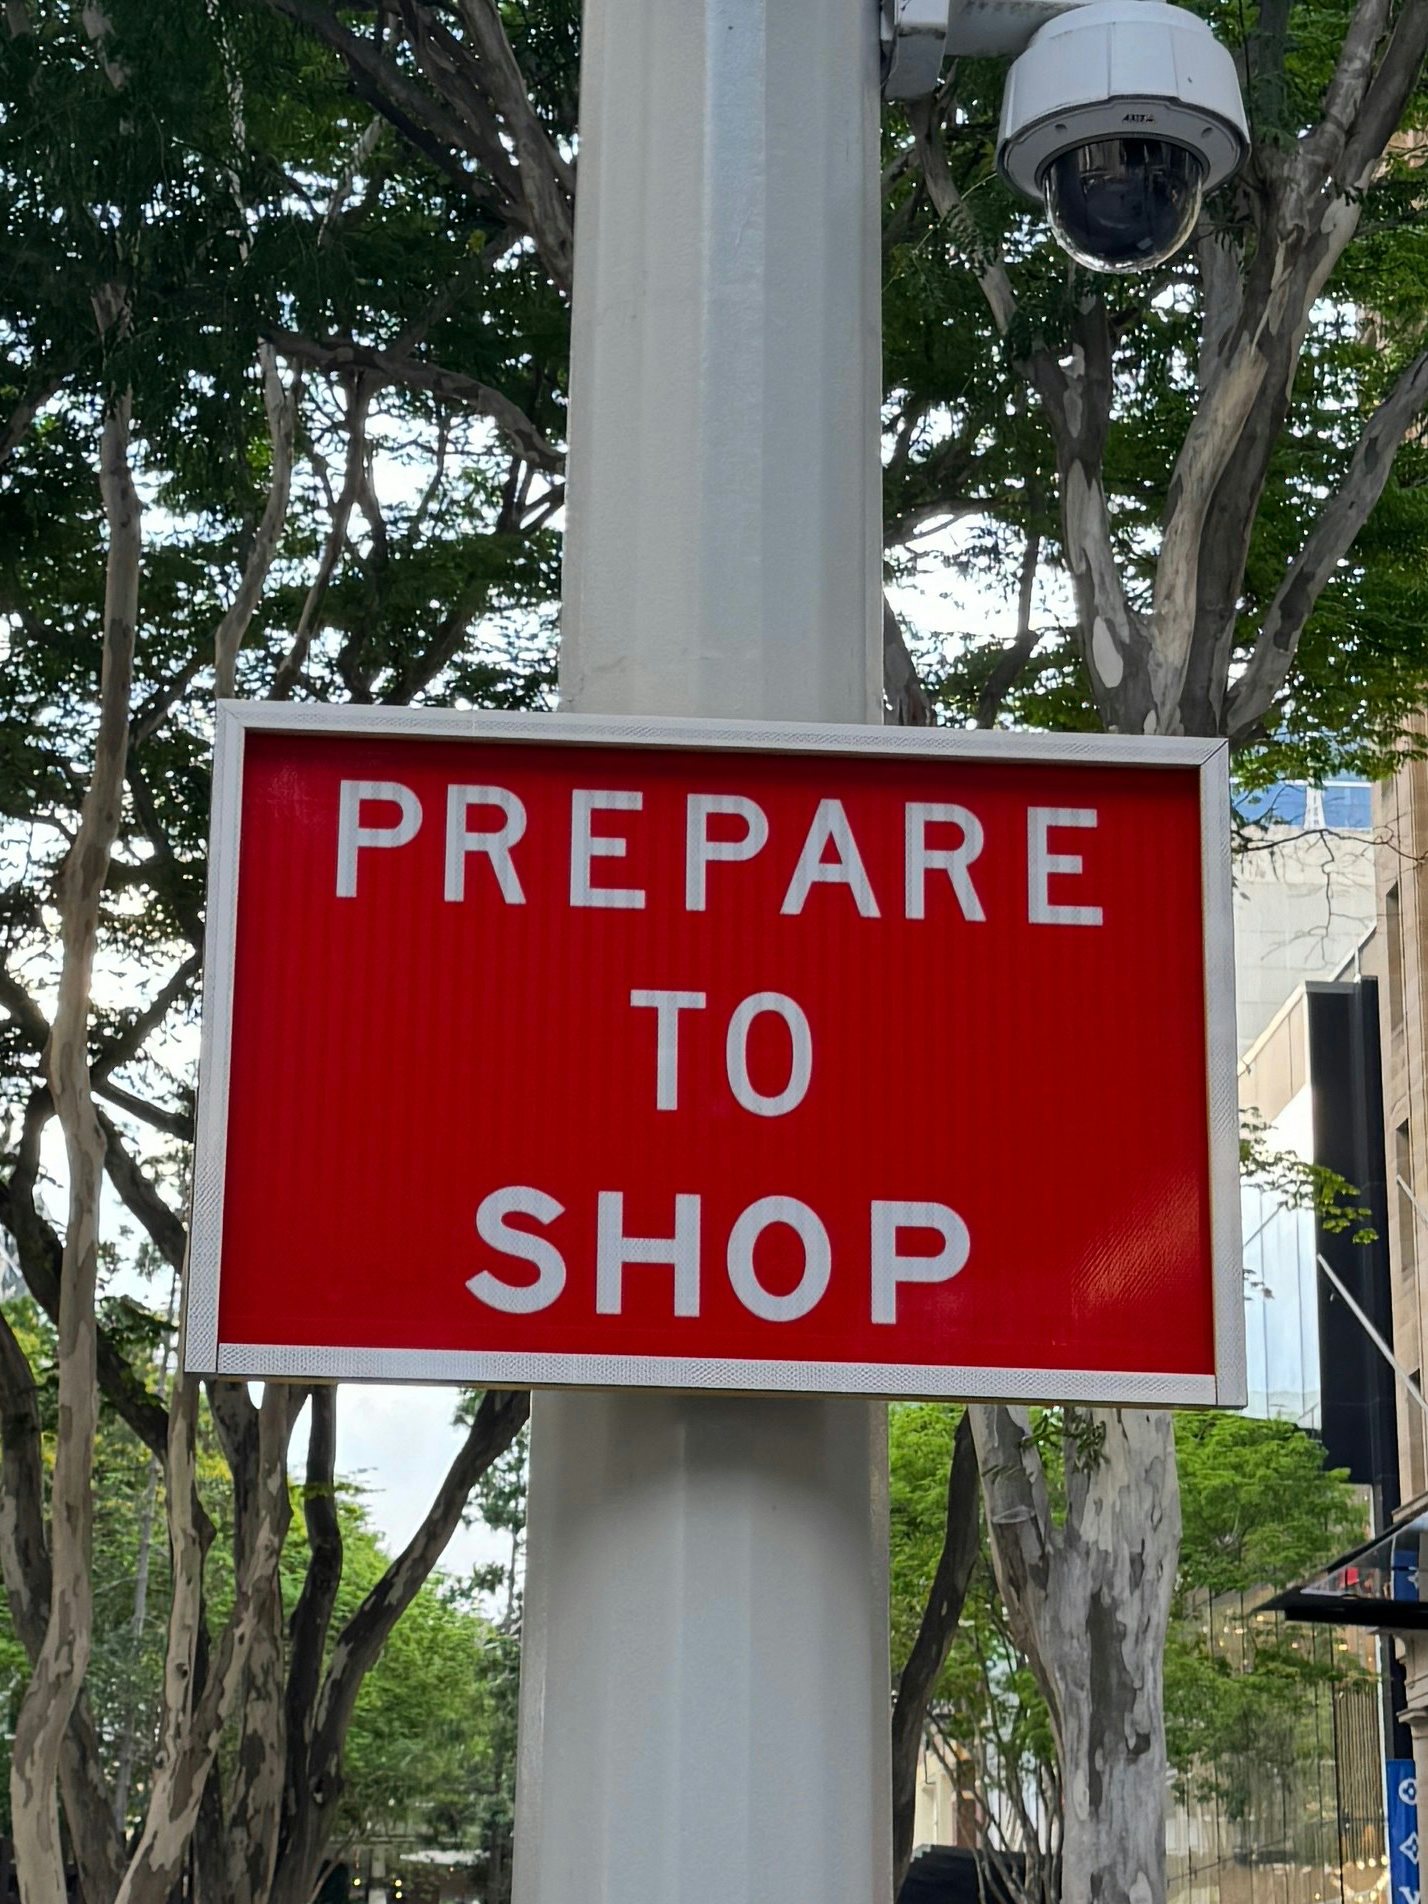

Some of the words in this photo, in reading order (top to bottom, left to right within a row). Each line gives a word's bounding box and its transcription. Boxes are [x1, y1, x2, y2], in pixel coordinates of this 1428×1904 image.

[335, 779, 1104, 927] PREPARE
[630, 990, 813, 1118] TO
[466, 1185, 971, 1325] SHOP
